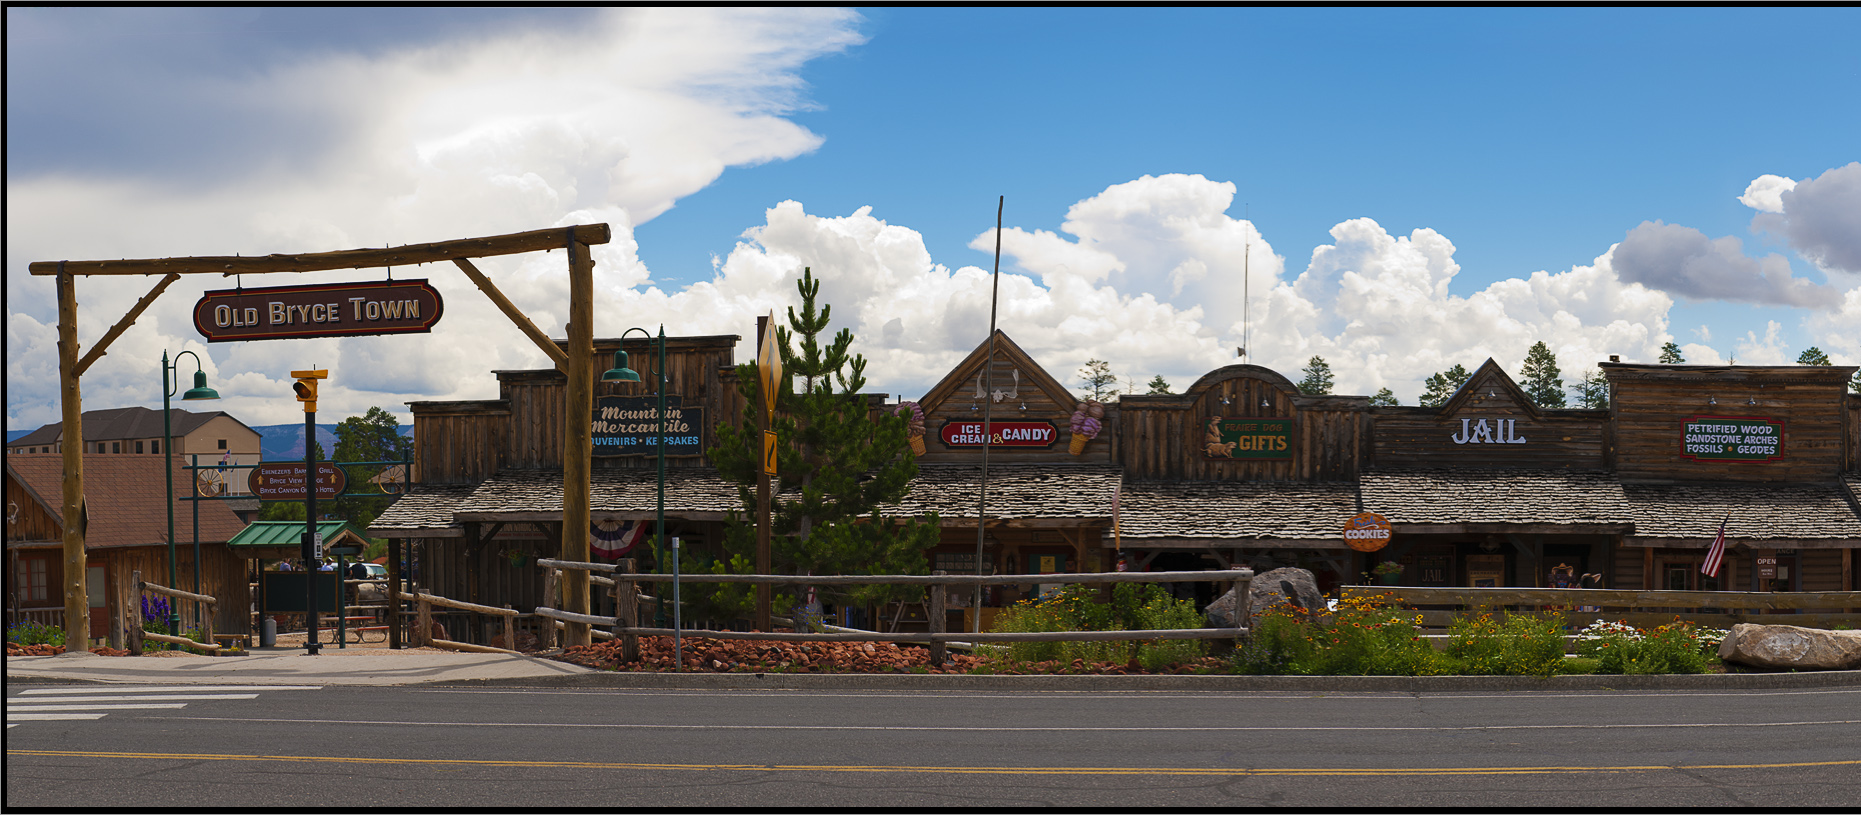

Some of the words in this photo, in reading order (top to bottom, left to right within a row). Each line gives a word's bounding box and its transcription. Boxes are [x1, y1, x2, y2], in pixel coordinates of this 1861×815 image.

[214, 303, 259, 328] OLD
[348, 297, 421, 321] TOWN
[961, 425, 981, 434] ICE
[1263, 424, 1283, 432] DOG
[1451, 418, 1527, 444] JAIL
[1688, 424, 1737, 434] PETRIFIED
[1740, 425, 1773, 434] WOOD
[646, 436, 699, 446] KEPSAKES
[993, 433, 1004, 444] &
[1002, 428, 1051, 440] CANDY
[1686, 434, 1742, 444] SANDSTONE
[1744, 436, 1778, 445] ARCHES
[1239, 435, 1287, 451] GIFTS
[1686, 444, 1723, 453] FOSSILS
[1737, 445, 1775, 455] GEODES
[1345, 529, 1390, 539] COOKIES
